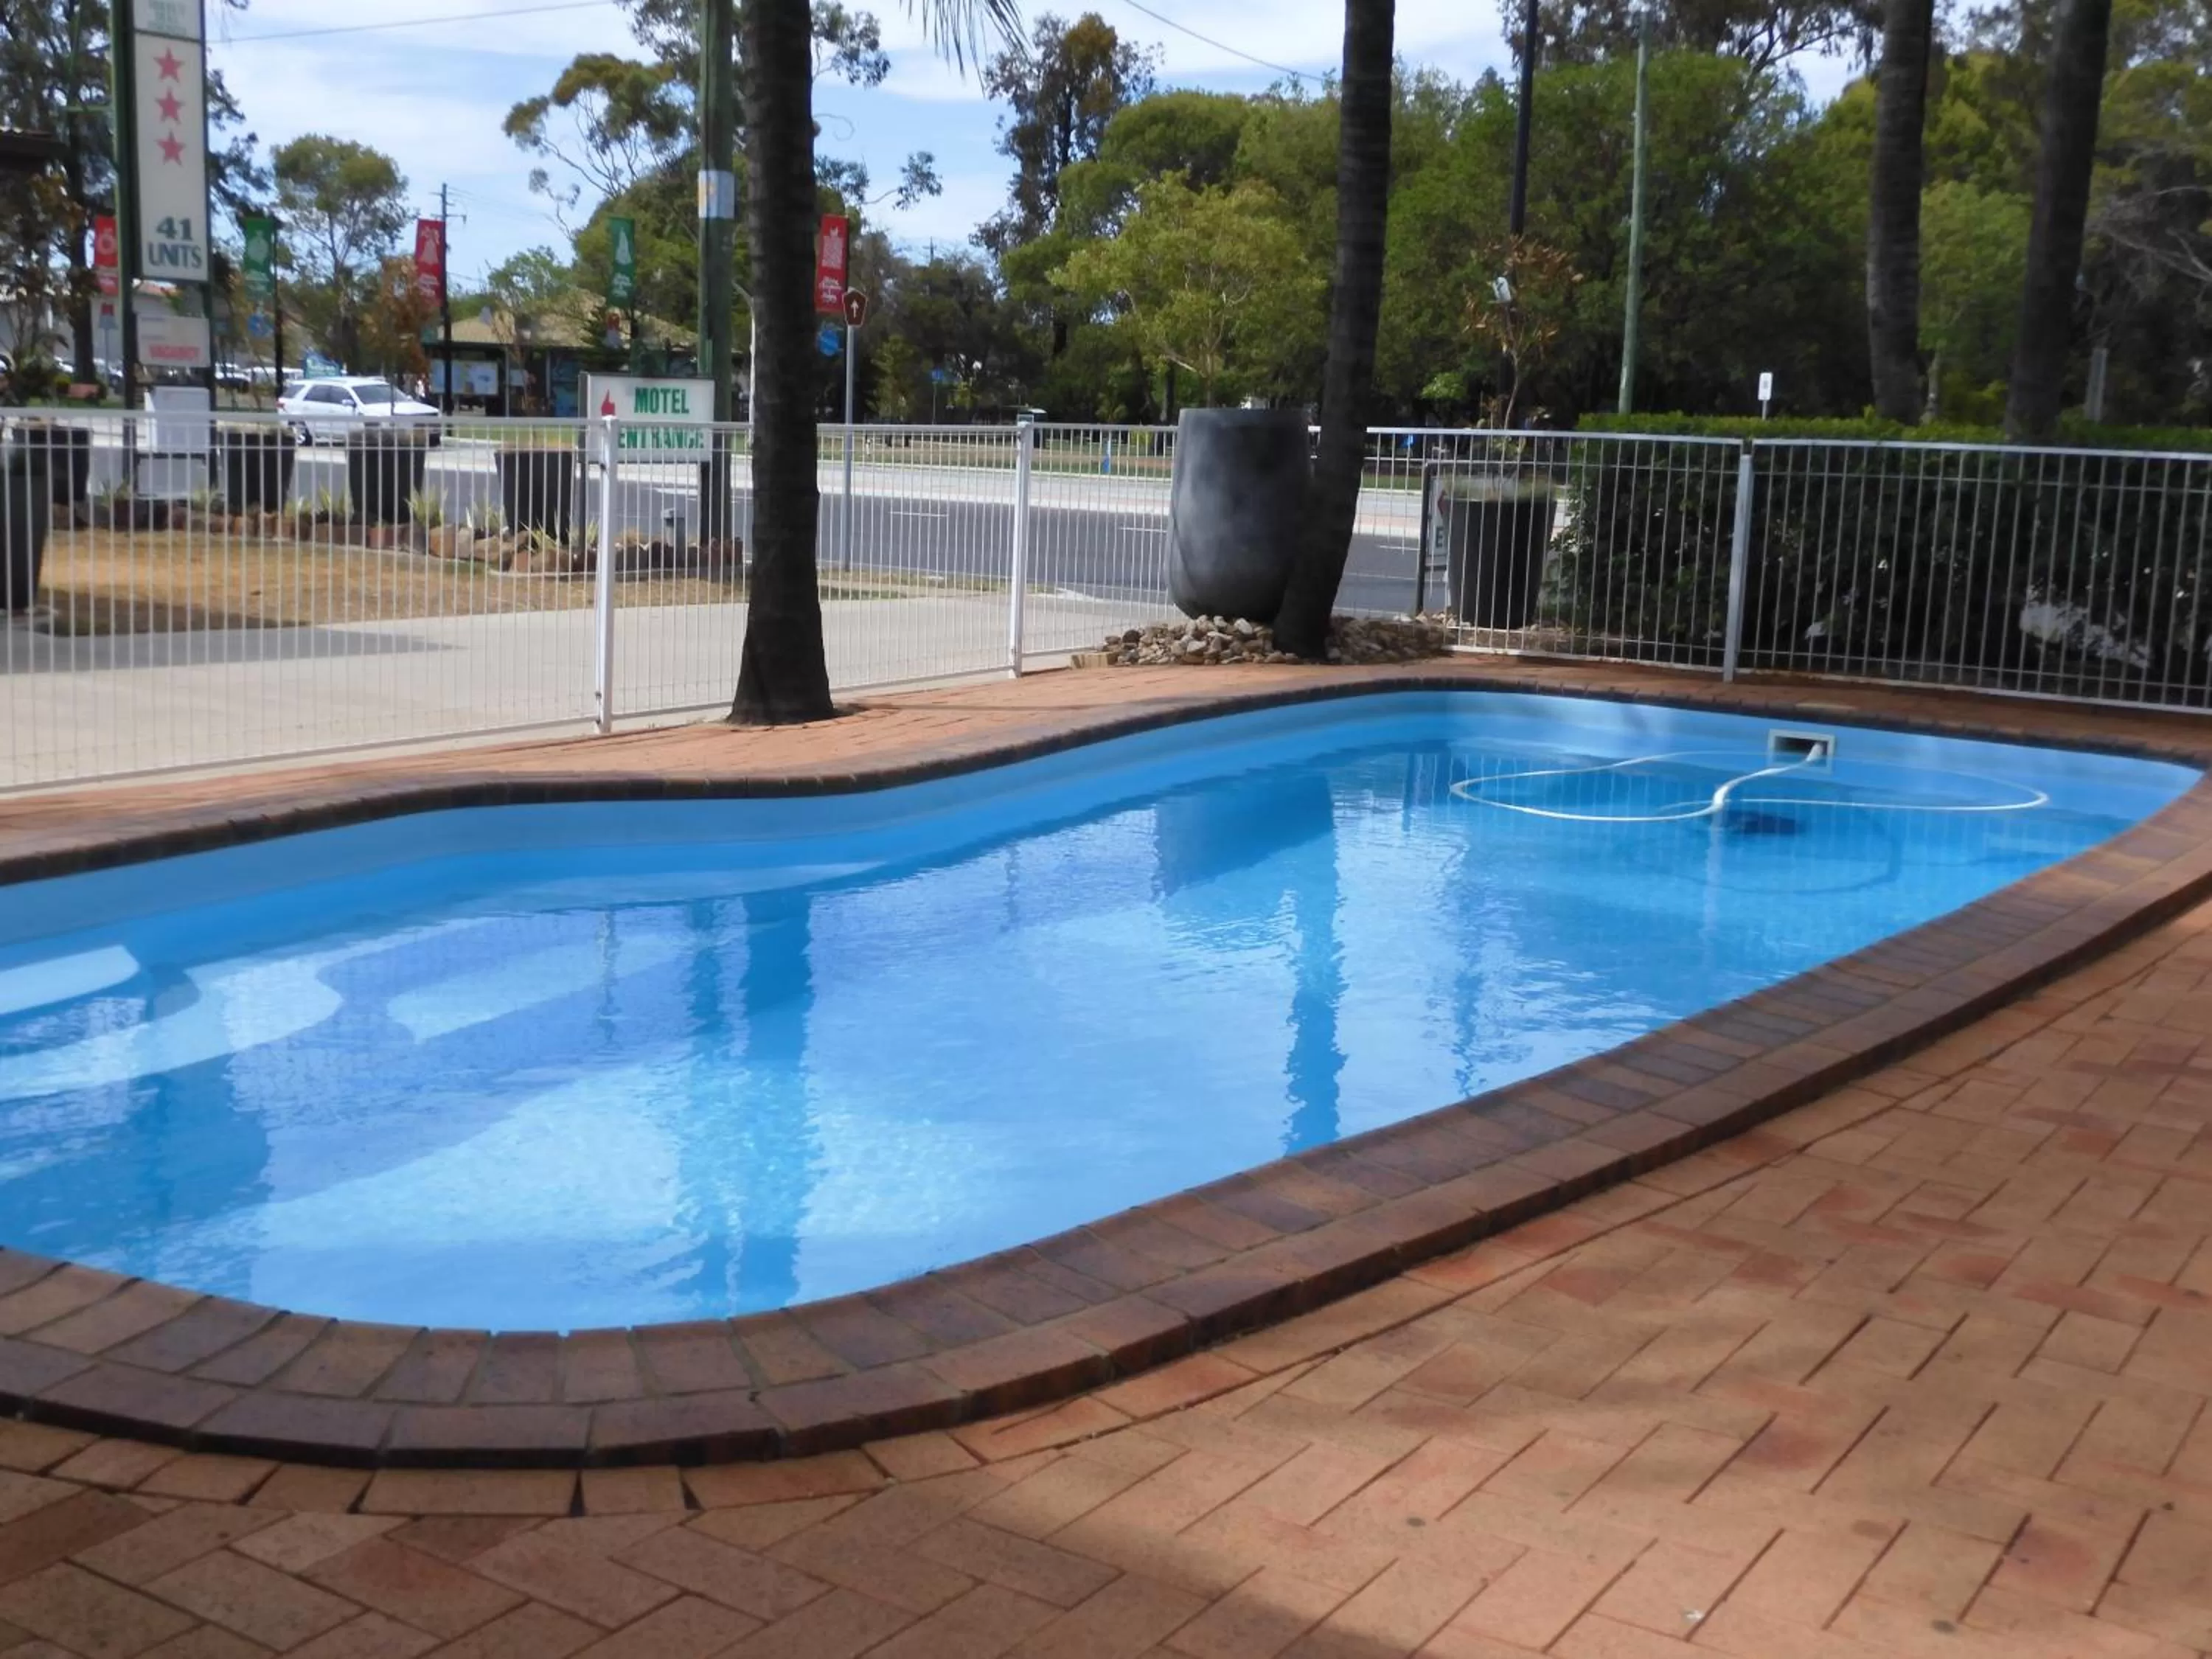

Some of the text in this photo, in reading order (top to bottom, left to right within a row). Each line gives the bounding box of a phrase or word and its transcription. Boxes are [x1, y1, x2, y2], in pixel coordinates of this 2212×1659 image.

[156, 215, 192, 241] 41
[148, 242, 202, 268] UNITS
[633, 387, 689, 414] MOTEL
